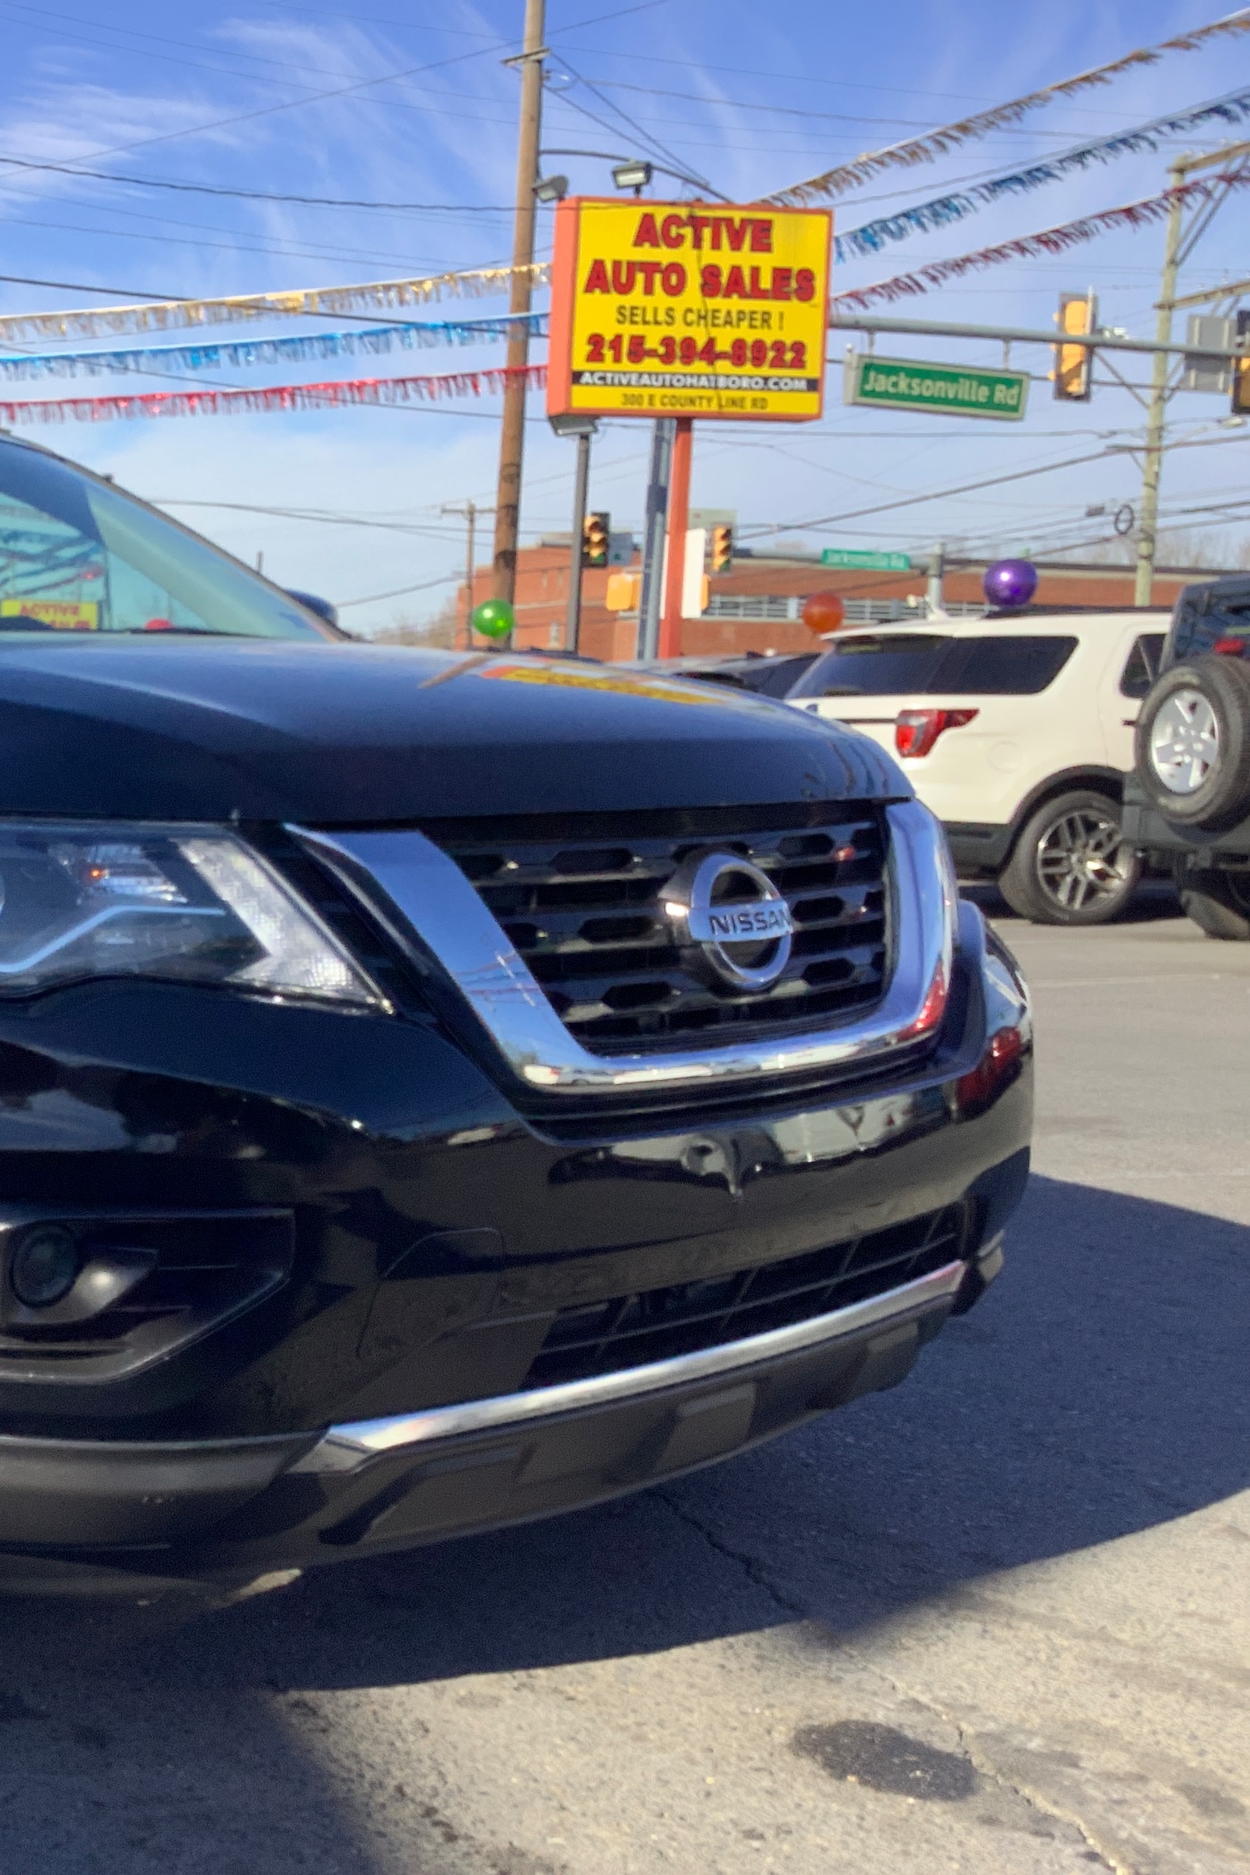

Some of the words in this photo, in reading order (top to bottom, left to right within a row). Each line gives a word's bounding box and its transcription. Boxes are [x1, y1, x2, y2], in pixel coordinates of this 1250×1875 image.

[633, 213, 773, 253] ACTIVE
[584, 259, 687, 296] AUTO
[701, 264, 815, 302] SALES
[616, 305, 676, 327] SELLS
[682, 307, 772, 330] CHEAPER
[585, 333, 807, 369] 215-394-8922
[580, 371, 807, 391] ACTIVEAUTOHATBORO.COM
[865, 371, 989, 402] Jacksonville
[993, 383, 1020, 406] Rd
[660, 394, 714, 409] COUNTY
[709, 908, 790, 935] NISSAN
